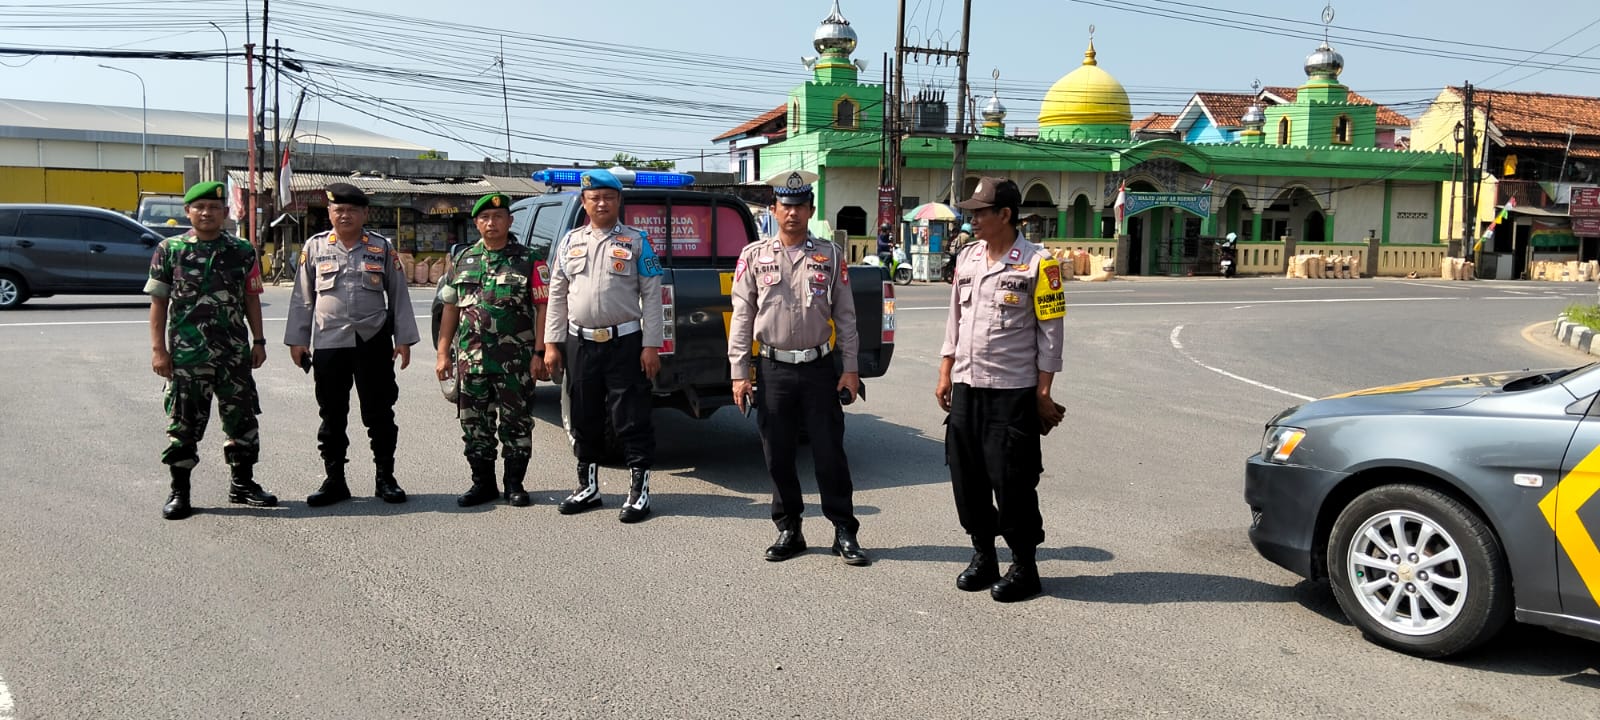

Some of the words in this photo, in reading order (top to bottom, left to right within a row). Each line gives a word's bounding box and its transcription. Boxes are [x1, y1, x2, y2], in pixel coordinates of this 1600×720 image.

[633, 217, 661, 225] BAKTI
[663, 217, 693, 225] OLDA
[684, 243, 697, 251] 110
[806, 264, 831, 273] POLRI
[1001, 280, 1028, 290] POLRI
